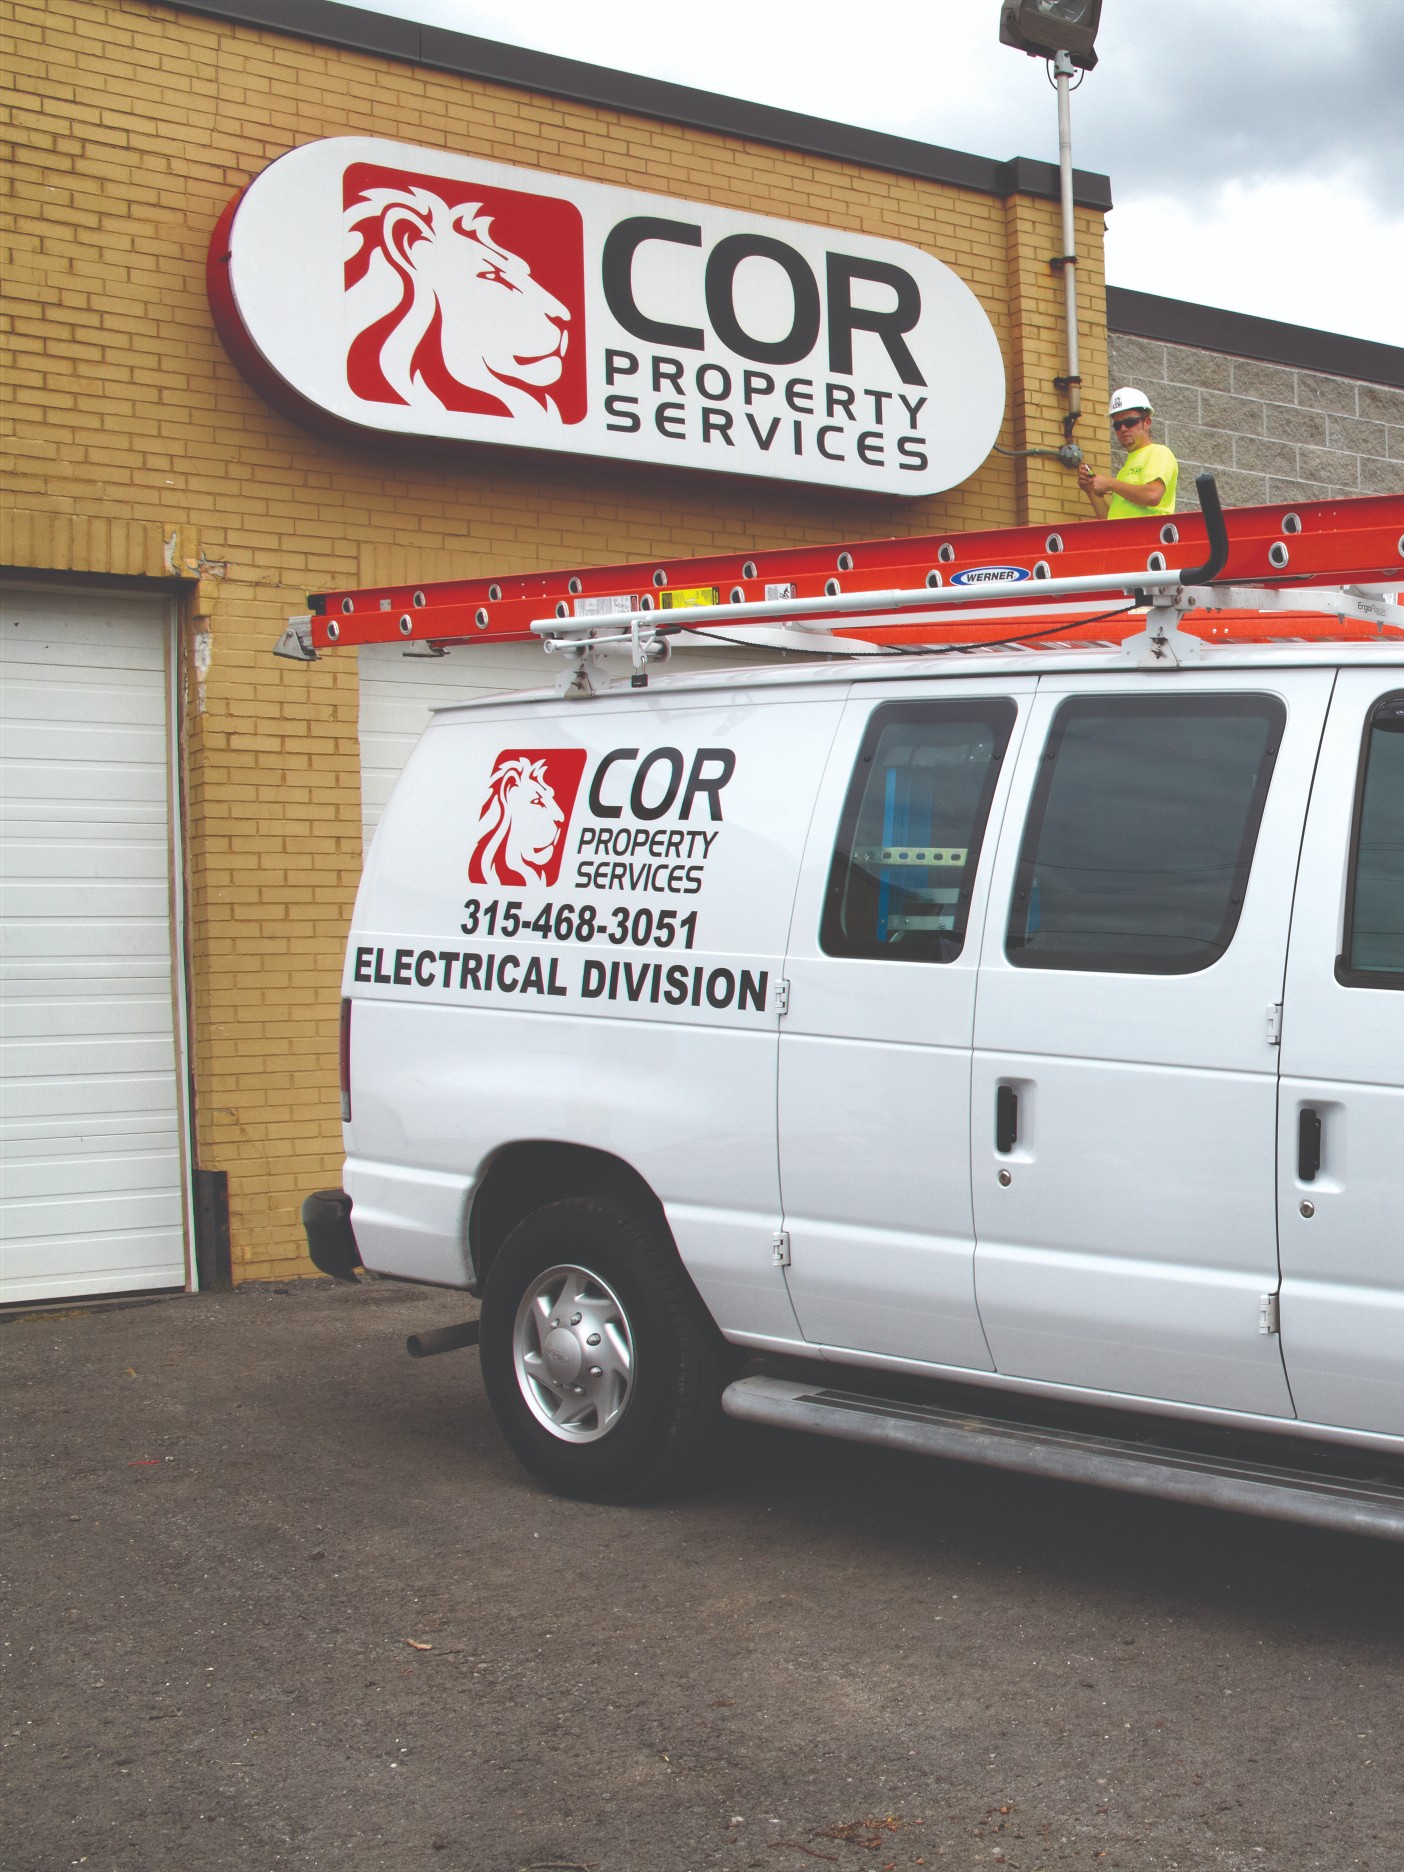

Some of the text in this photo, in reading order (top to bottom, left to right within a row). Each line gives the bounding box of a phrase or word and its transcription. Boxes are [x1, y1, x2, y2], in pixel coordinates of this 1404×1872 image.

[601, 216, 928, 388] COR
[604, 348, 928, 430] PROPERTY
[604, 394, 928, 472] SERVICES
[966, 571, 1015, 582] WERNER
[588, 746, 736, 822] COR
[577, 827, 719, 860] PROPERTY
[574, 860, 705, 894] SERVICES
[460, 898, 699, 950] 315-468-3051
[354, 946, 769, 1012] ELECTRICAL DIVISION
